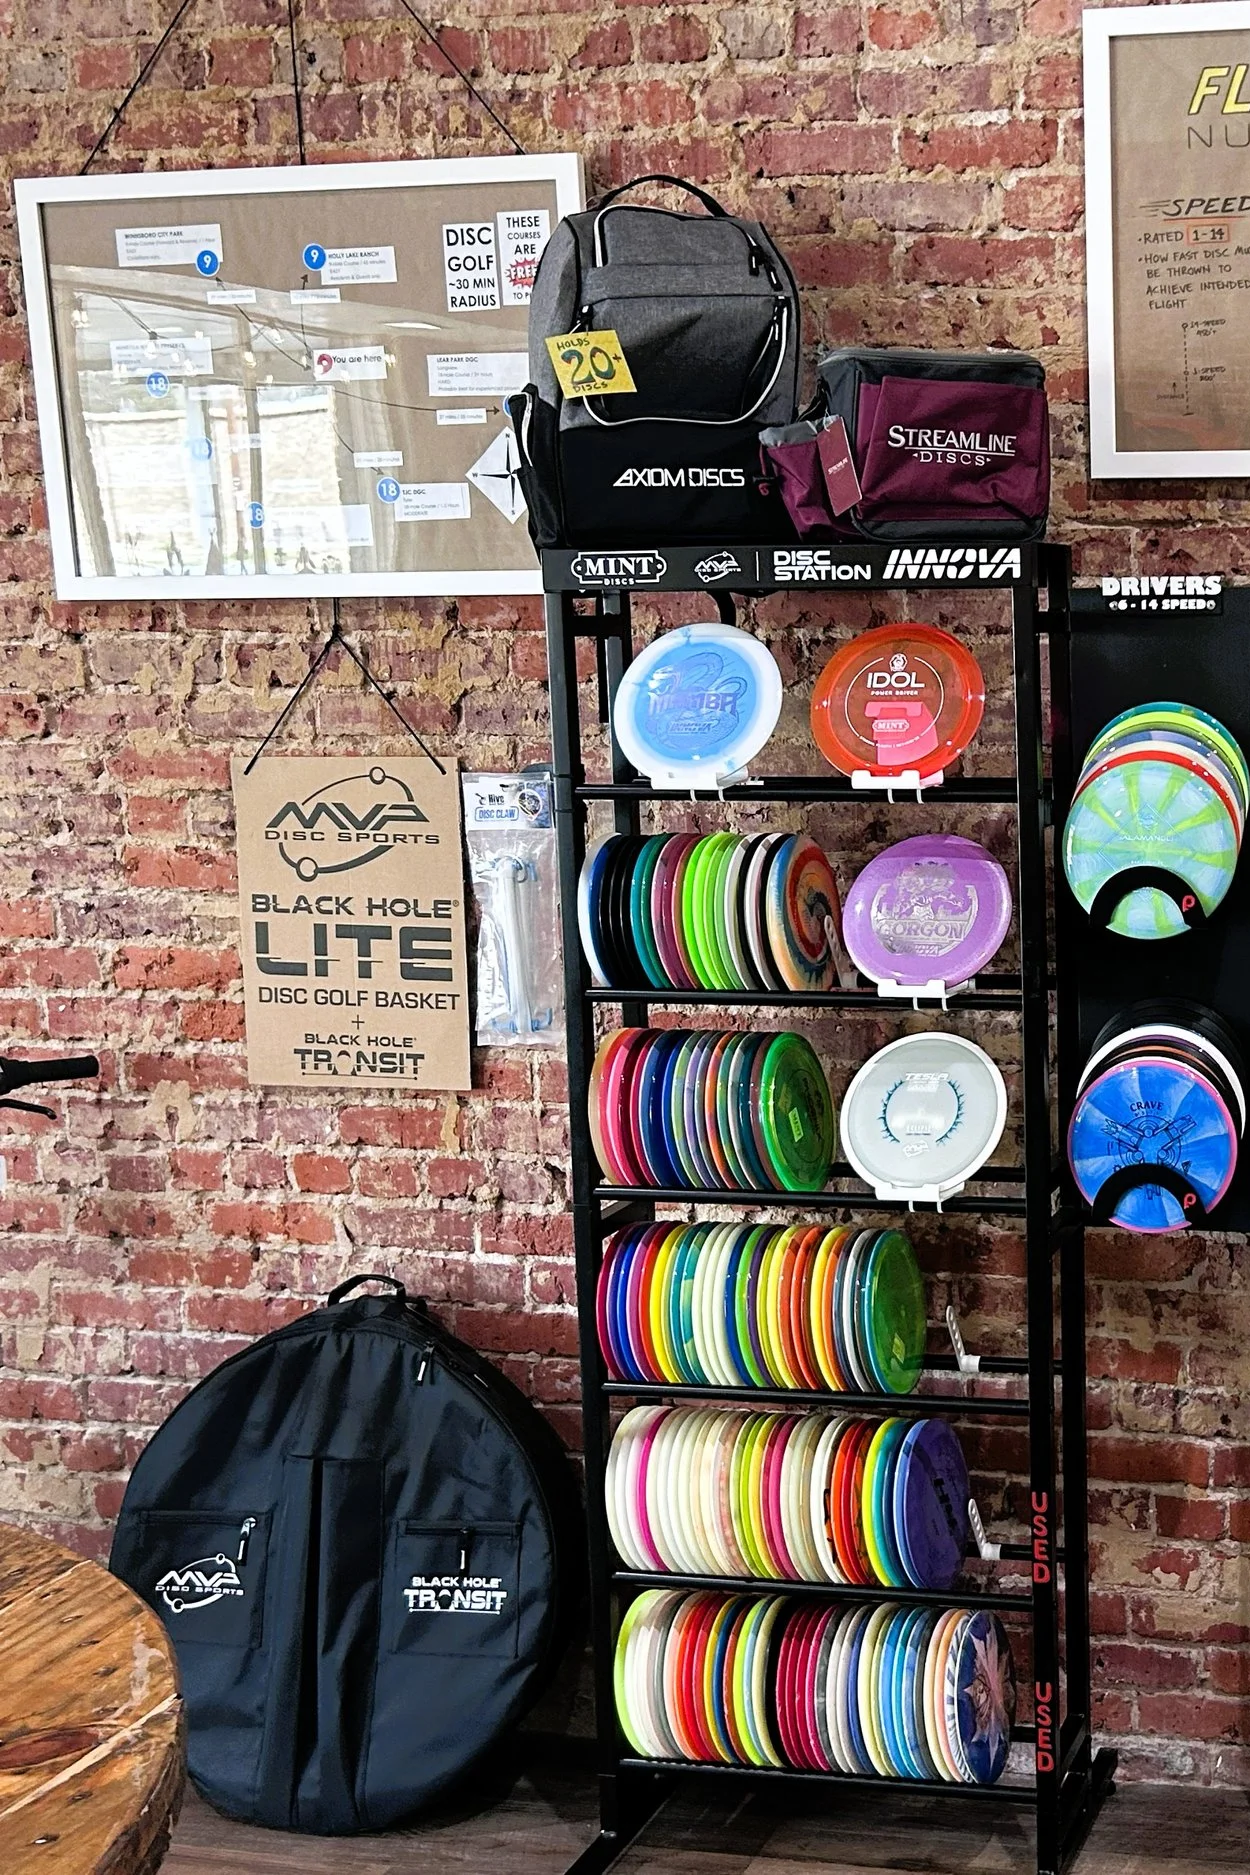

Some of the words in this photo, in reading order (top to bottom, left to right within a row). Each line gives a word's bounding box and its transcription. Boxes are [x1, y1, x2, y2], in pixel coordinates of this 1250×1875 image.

[506, 216, 540, 228] THESE
[446, 227, 492, 247] DISC
[507, 231, 541, 240] COURSES
[1143, 231, 1184, 244] RATED
[310, 249, 319, 263] 9
[514, 244, 536, 255] ARE
[1145, 253, 1168, 264] HOW
[1173, 251, 1198, 261] FAST
[1204, 249, 1229, 258] DISC
[203, 254, 211, 268] 9
[448, 255, 494, 272] GOLF
[1146, 269, 1160, 279] BE
[1167, 265, 1210, 276] THROWN
[1218, 264, 1232, 273] TO
[449, 278, 470, 290] ~30
[473, 277, 495, 289] MIN
[1146, 283, 1193, 296] ACHIEVE
[450, 295, 496, 308] RADIUS
[513, 292, 523, 300] TO
[1149, 299, 1187, 310] FLIGHT
[556, 338, 590, 351] HOLDS
[332, 356, 347, 364] You
[363, 355, 382, 363] here
[150, 377, 166, 391] 18
[573, 381, 608, 393] DISCS
[888, 425, 1017, 454] STREAMLINE
[919, 451, 985, 466] DISCS
[613, 468, 685, 487] AXIOM
[688, 468, 745, 487] DISCS
[380, 482, 397, 497] 18
[695, 560, 739, 570] MVP
[773, 550, 831, 566] DISC
[882, 548, 1021, 579] INNOVA
[583, 557, 654, 576] MINT
[774, 564, 871, 581] STATION
[603, 577, 634, 586] DISCS
[1101, 575, 1222, 597] DRIVERS
[1117, 600, 1127, 611] 6
[1140, 600, 1158, 610] 14
[1161, 599, 1206, 610] SPEED
[866, 672, 925, 688] IDOL
[488, 794, 505, 803] Hive
[265, 801, 430, 831] MVP
[479, 809, 495, 819] DISC
[495, 808, 516, 819] CLAW
[264, 829, 325, 842] DISC
[337, 831, 440, 845] SPORTS
[251, 893, 354, 916] BLACK
[879, 921, 965, 939] GORGON
[254, 921, 453, 982] LITE
[258, 986, 308, 1005] DISC
[313, 987, 369, 1007] GOLF
[375, 990, 460, 1011] BASKET
[304, 1032, 360, 1046] BLACK
[293, 1048, 425, 1075] TRANSIT
[905, 1072, 949, 1081] TESLA
[1130, 1100, 1164, 1112] CRAVE
[1031, 1492, 1051, 1584] USED
[156, 1570, 241, 1588] MVP
[411, 1576, 460, 1588] BLACK
[463, 1577, 500, 1588] HOLE
[194, 1586, 244, 1596] SPORTS
[403, 1589, 507, 1610] TRANSIT
[1035, 1681, 1055, 1772] USED
